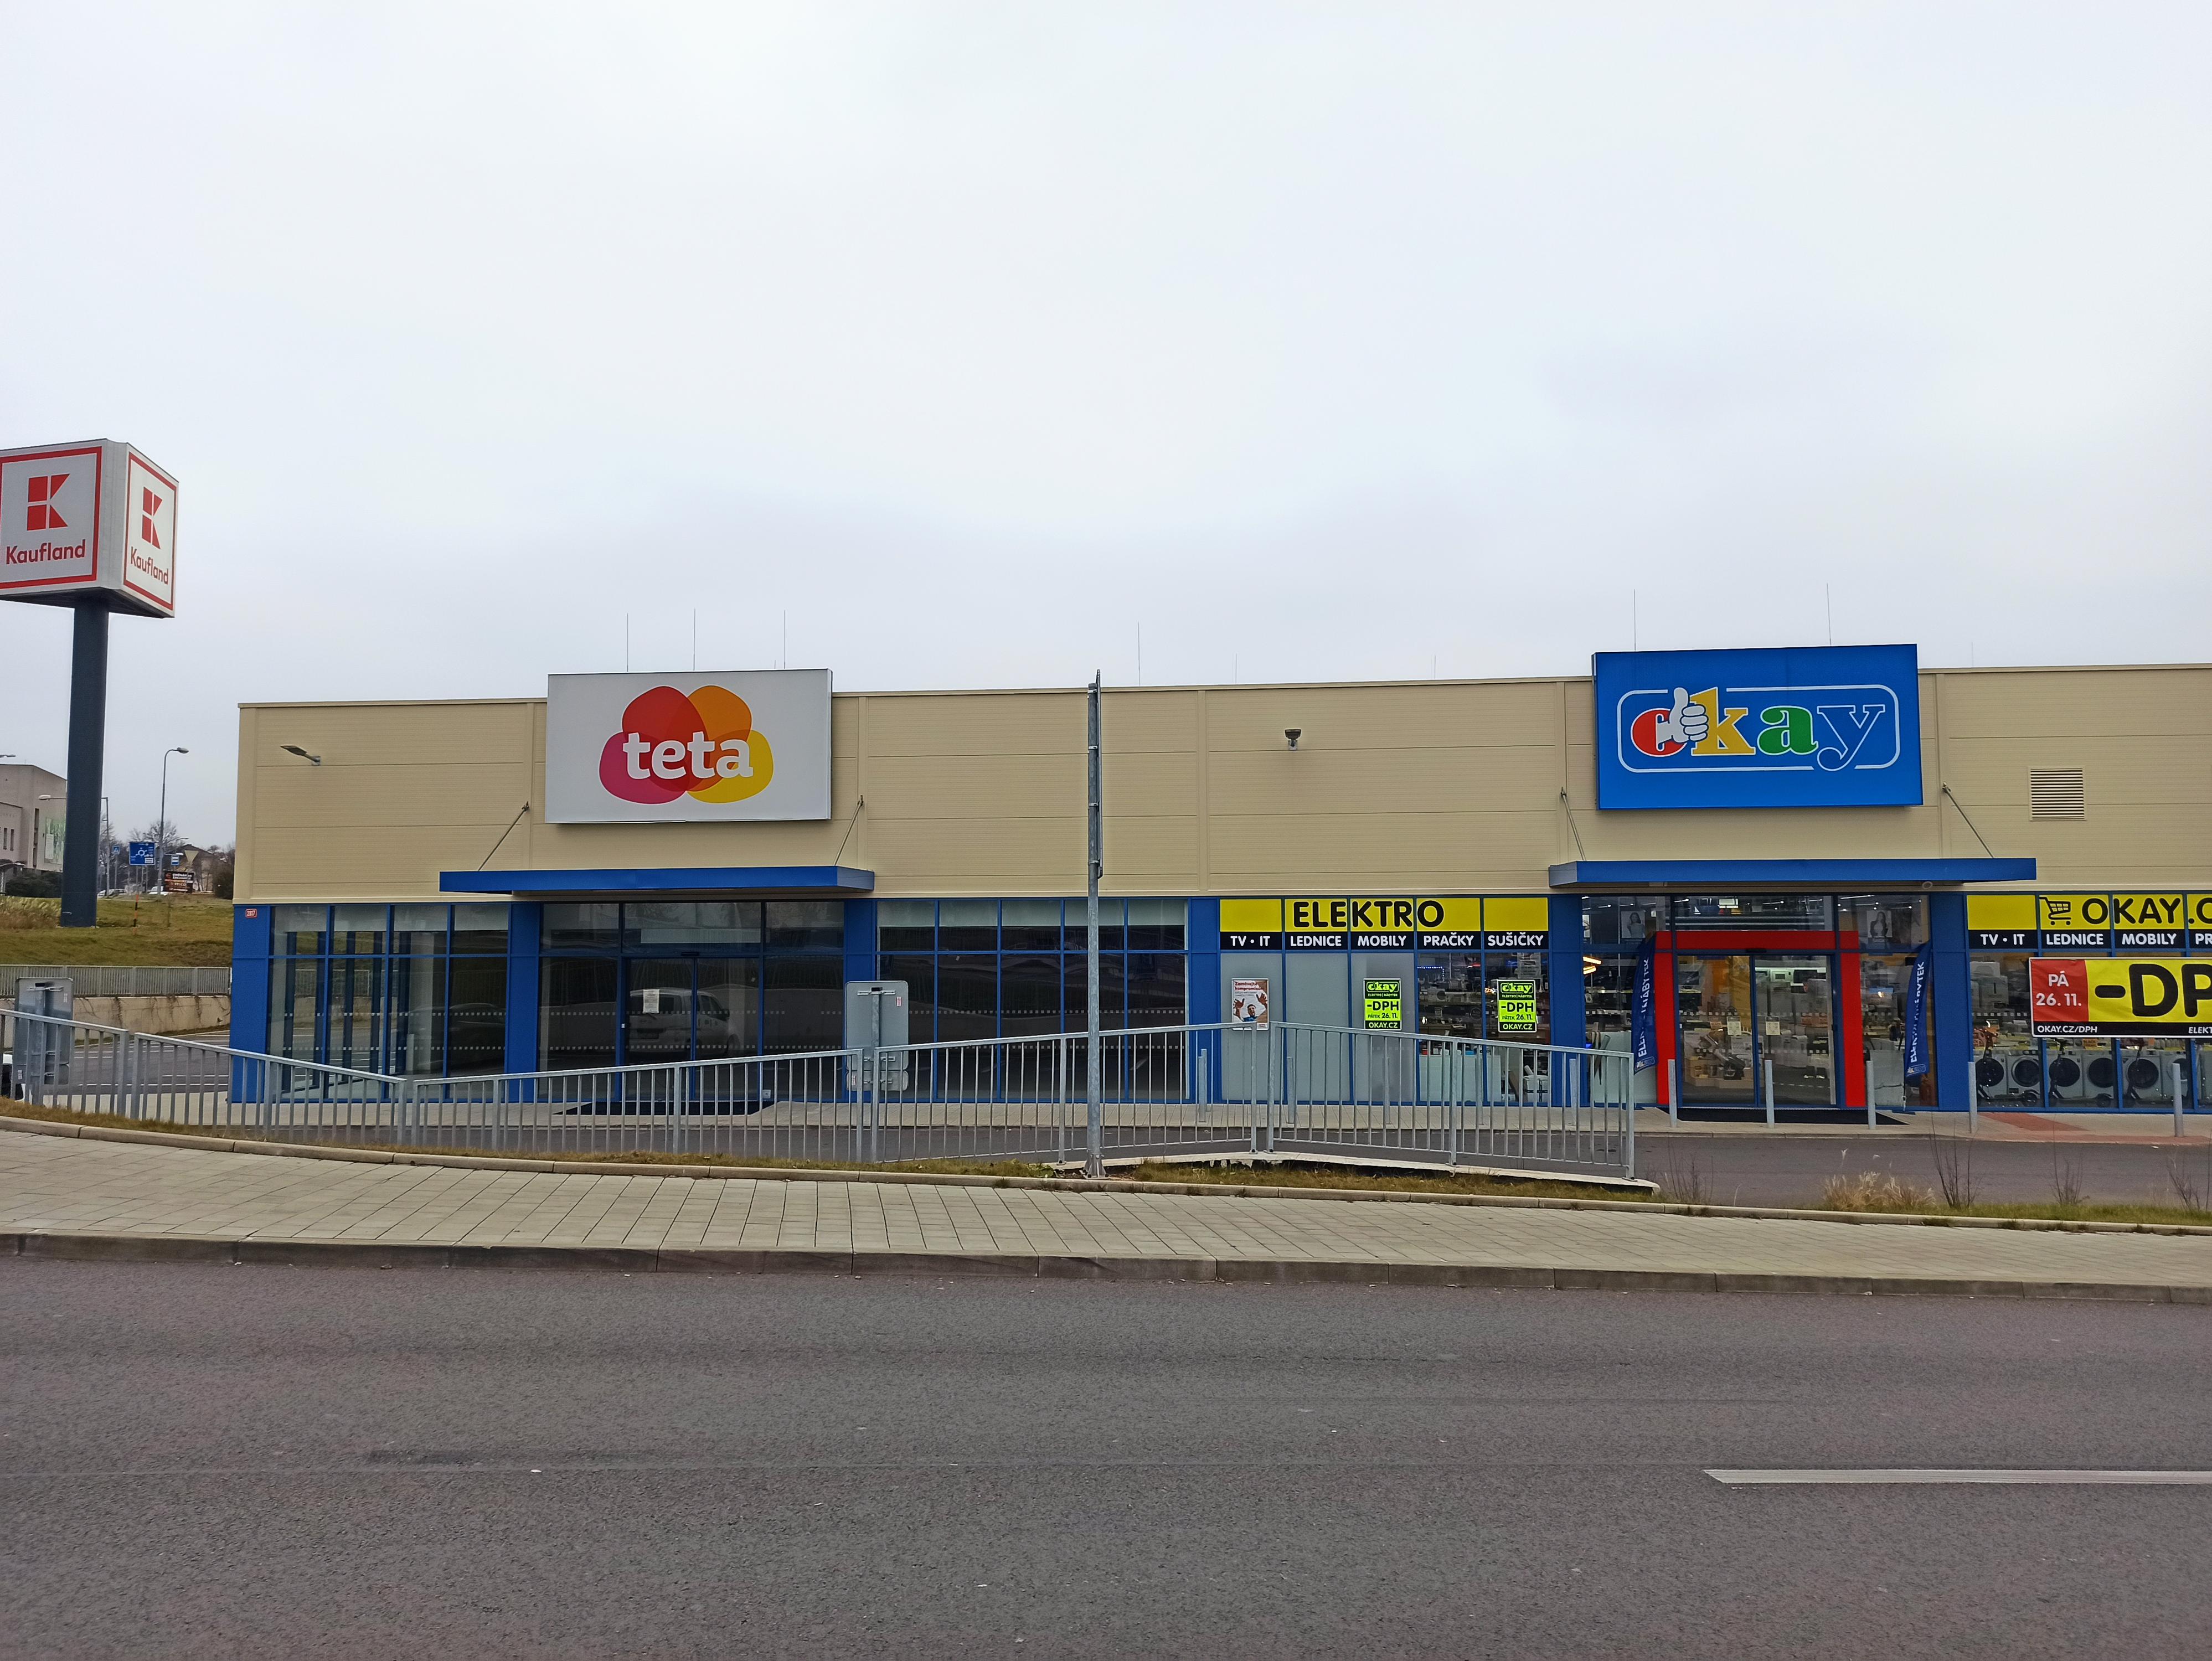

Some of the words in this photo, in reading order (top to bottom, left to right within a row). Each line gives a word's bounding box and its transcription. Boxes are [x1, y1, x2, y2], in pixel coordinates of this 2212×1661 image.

[6, 539, 86, 564] Kaufland
[131, 546, 169, 585] Kaufland
[622, 731, 754, 780] teta
[1293, 900, 1445, 928] ELEKTRO
[1230, 936, 1246, 946] TV
[1260, 936, 1271, 946] IT
[1290, 936, 1342, 946] LEDNICE
[1357, 935, 1406, 946] MOBILY
[1424, 932, 1474, 946] PRAČKY
[1488, 931, 1544, 946] SUŠIČKY
[1981, 934, 1998, 945] TV
[2013, 934, 2025, 945] IT
[2046, 933, 2104, 945] LEDNICE
[2122, 933, 2177, 945] MOBILY
[2048, 971, 2069, 987] PÁ
[1367, 1001, 1399, 1011] -DPH
[1501, 1002, 1534, 1012] -DPH
